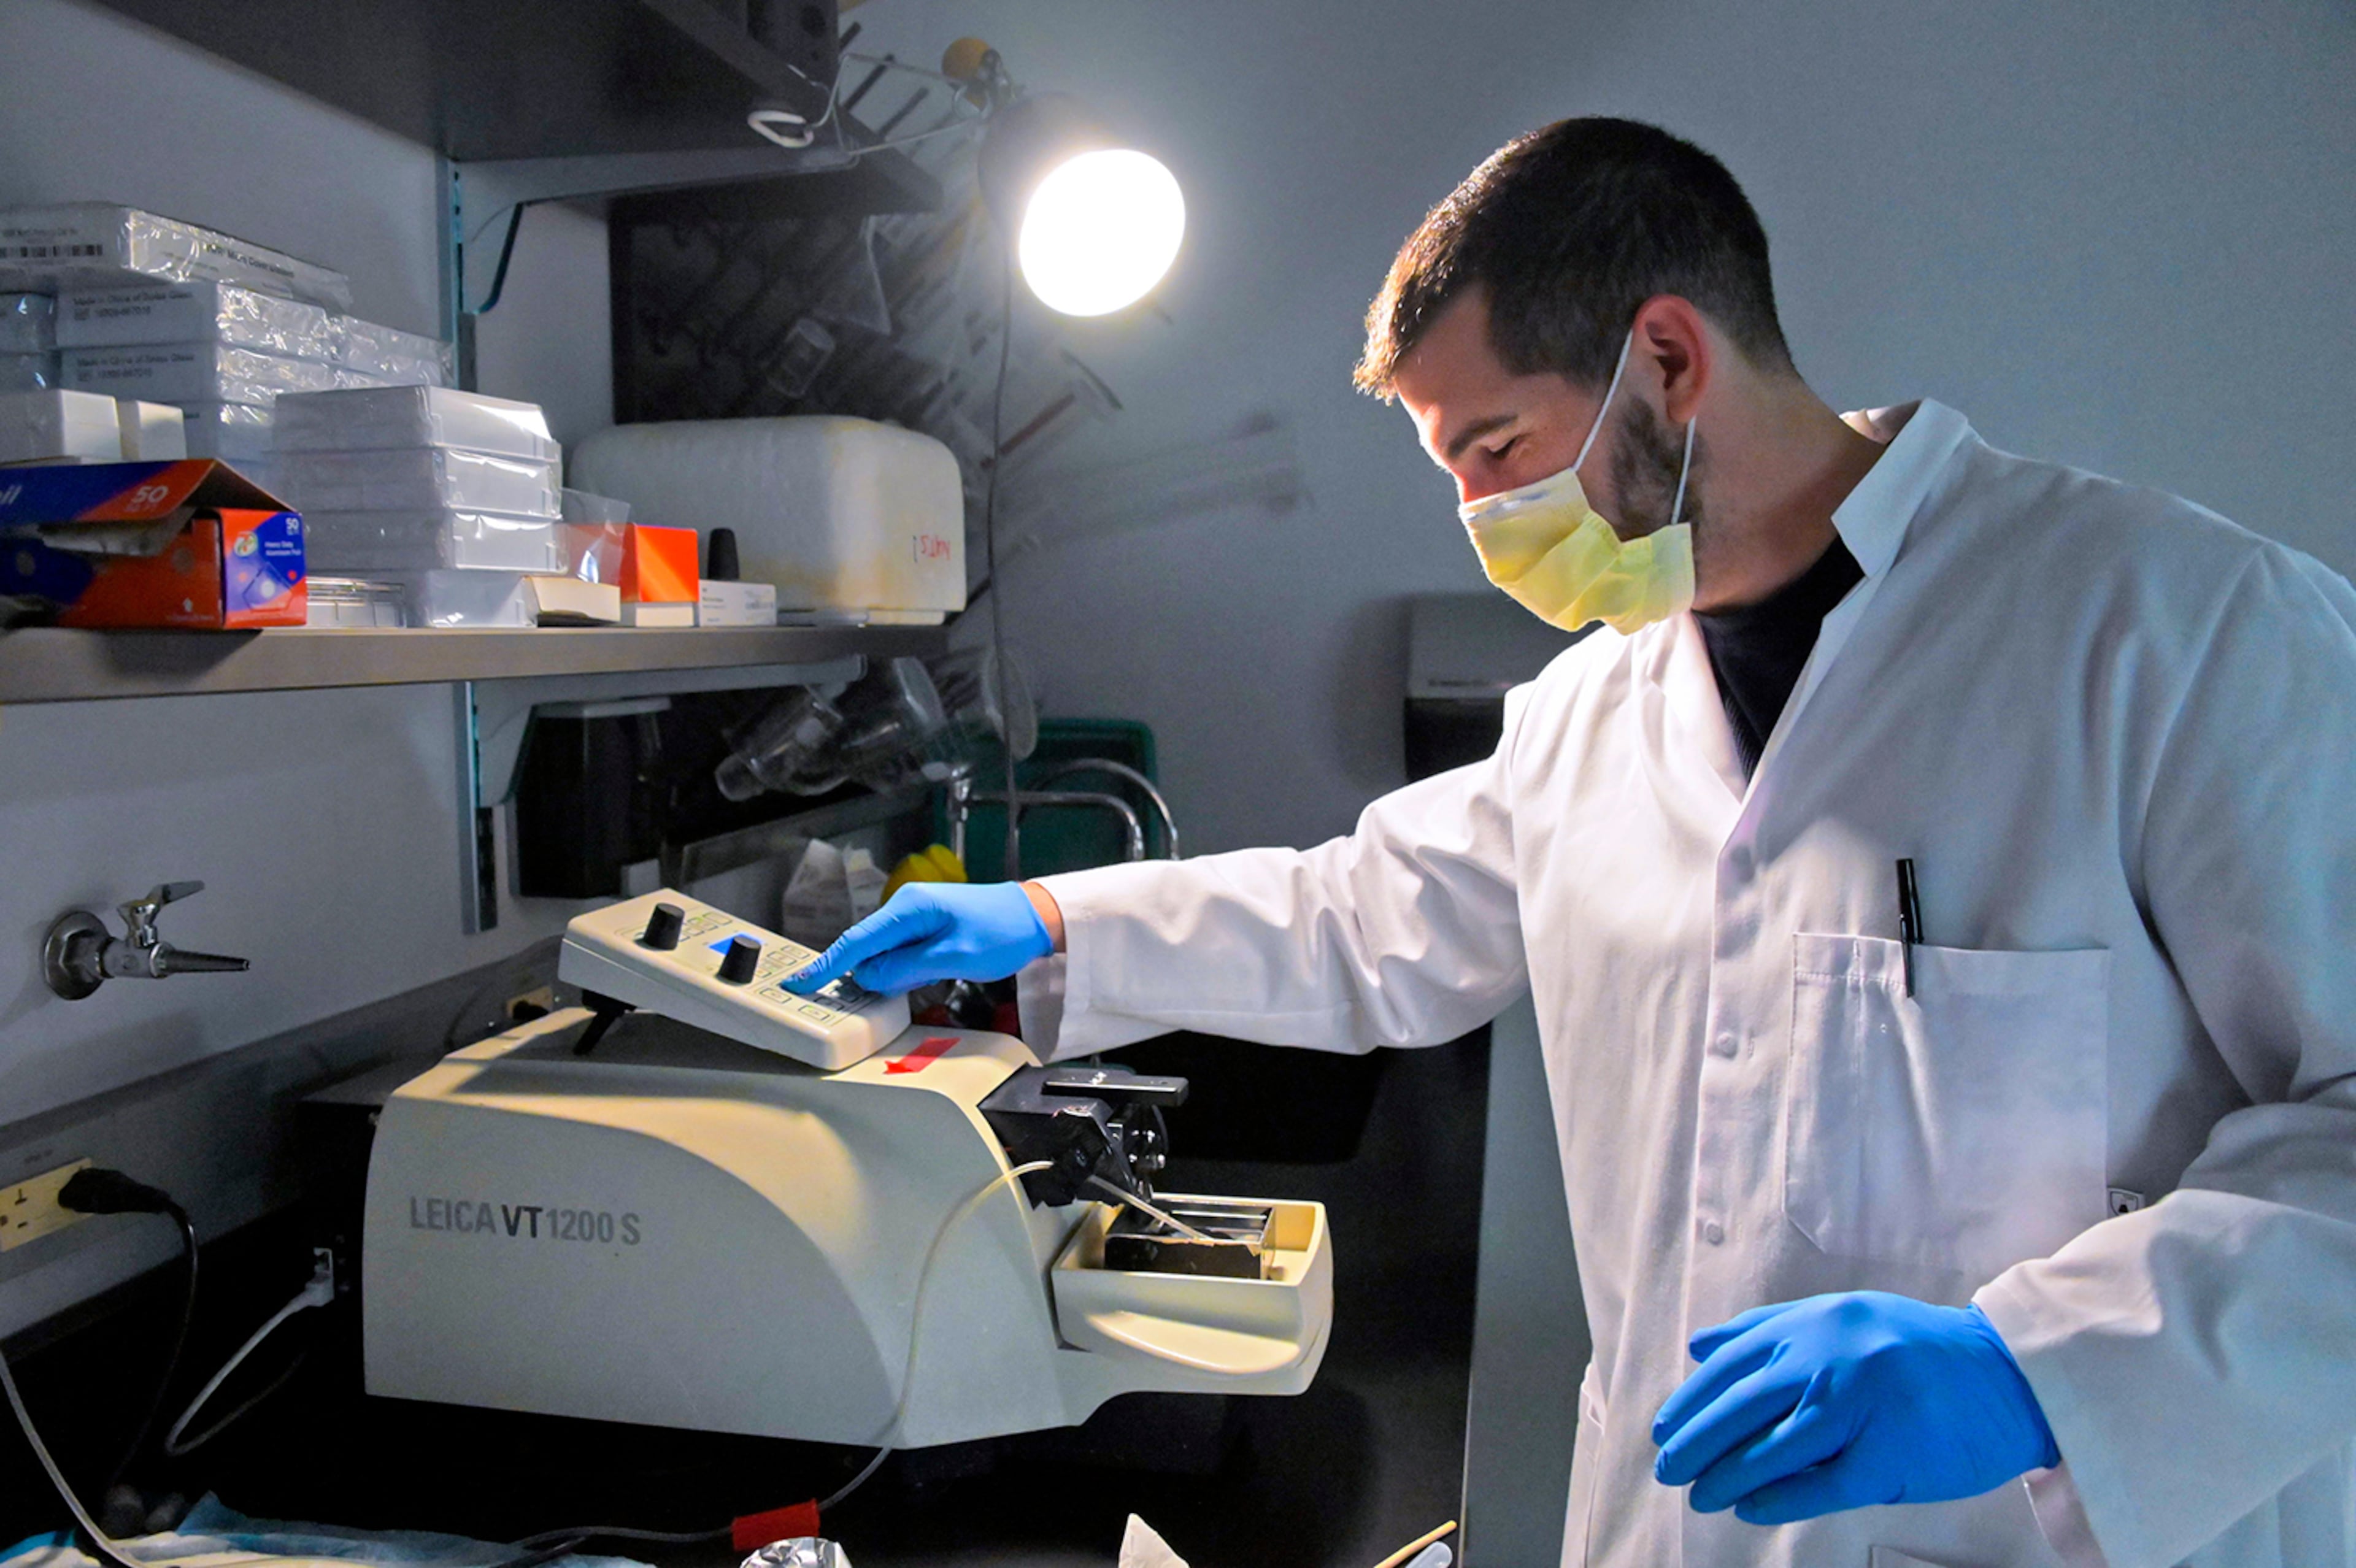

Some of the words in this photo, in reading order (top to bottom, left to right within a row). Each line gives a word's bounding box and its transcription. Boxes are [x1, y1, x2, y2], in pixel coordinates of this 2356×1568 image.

[131, 485, 169, 503] 50
[285, 517, 300, 530] 50
[409, 1196, 497, 1234] LEICA
[620, 1212, 641, 1246] S
